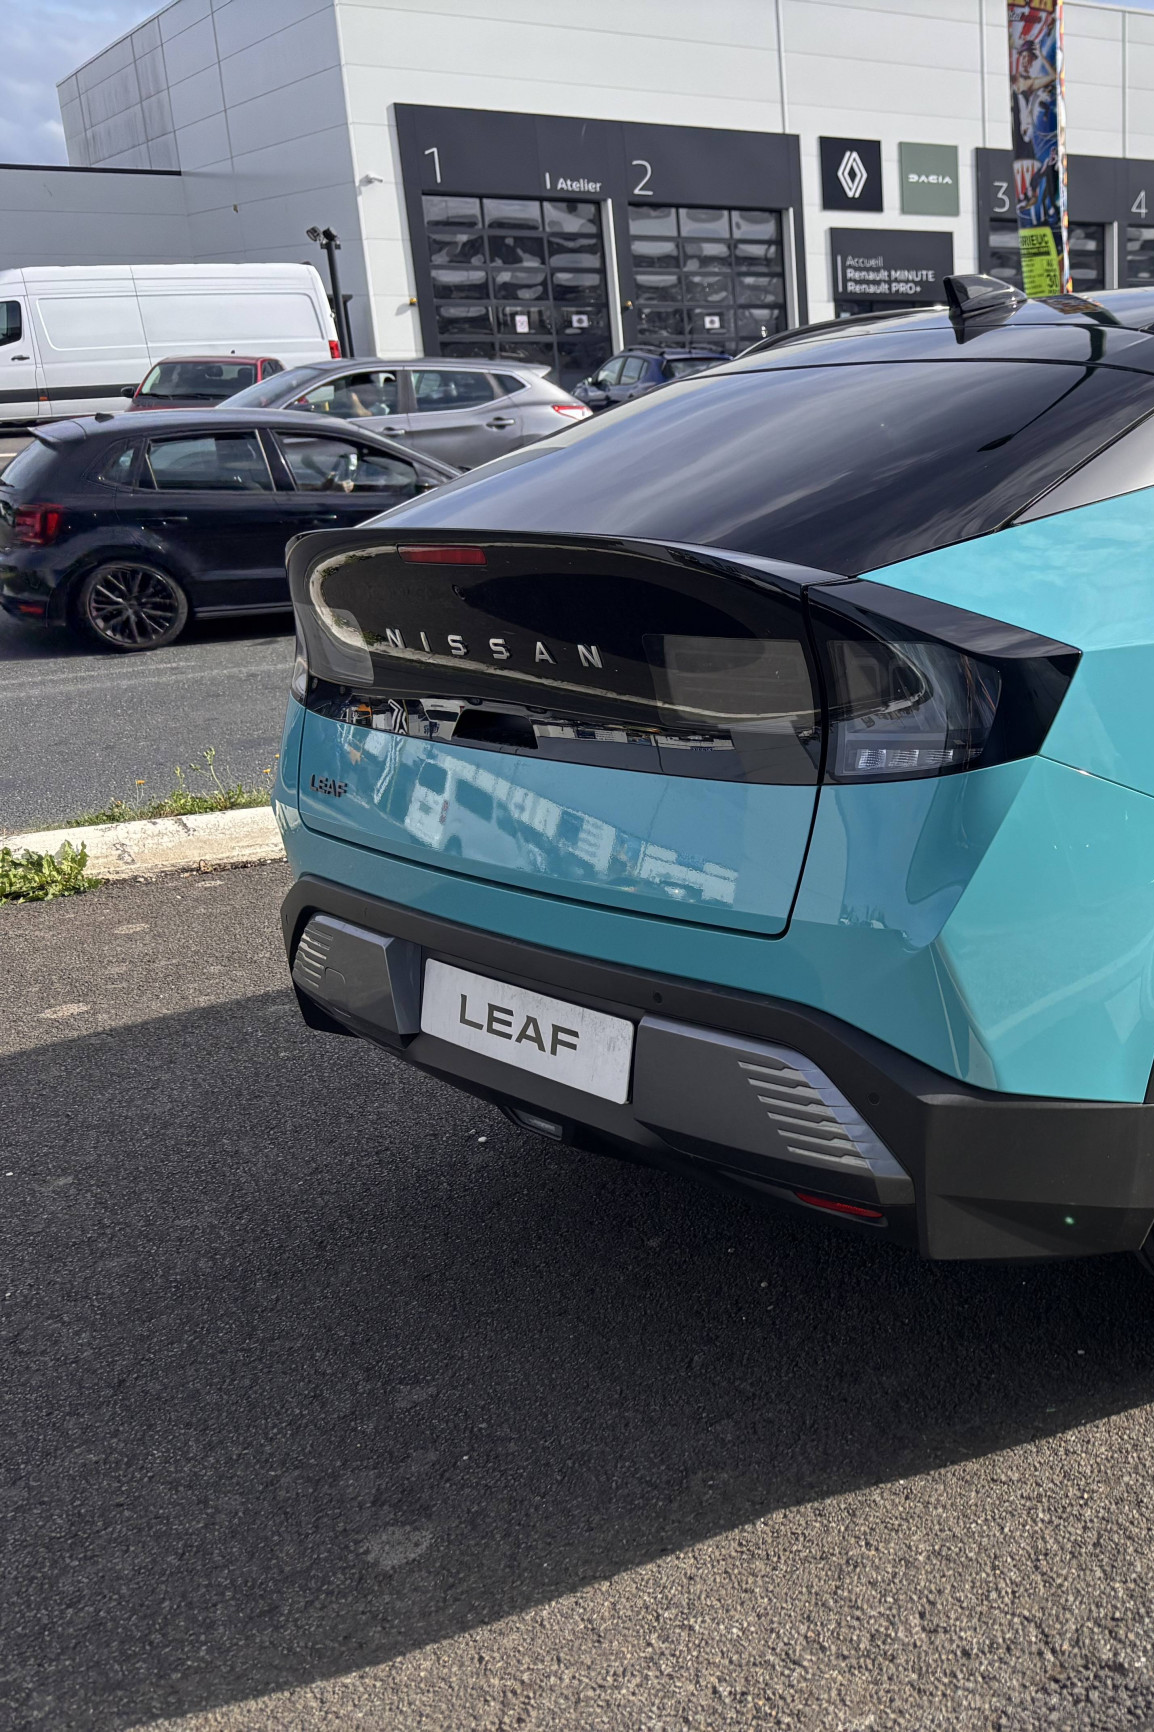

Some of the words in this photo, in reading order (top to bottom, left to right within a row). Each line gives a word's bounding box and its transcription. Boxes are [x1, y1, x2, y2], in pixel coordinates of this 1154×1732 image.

[424, 147, 441, 184] 1
[632, 160, 654, 196] 2
[908, 173, 953, 184] DACIA
[557, 177, 602, 192] Atelier
[993, 181, 1010, 213] 3
[1131, 189, 1148, 218] 4
[846, 256, 884, 267] Accueil
[846, 268, 889, 281] Renault
[891, 270, 936, 282] MINUTE
[847, 282, 890, 294] Renault
[891, 282, 922, 294] PRO+
[385, 628, 604, 669] NISSAN
[311, 774, 348, 798] LEAF
[460, 993, 580, 1057] LEAF
